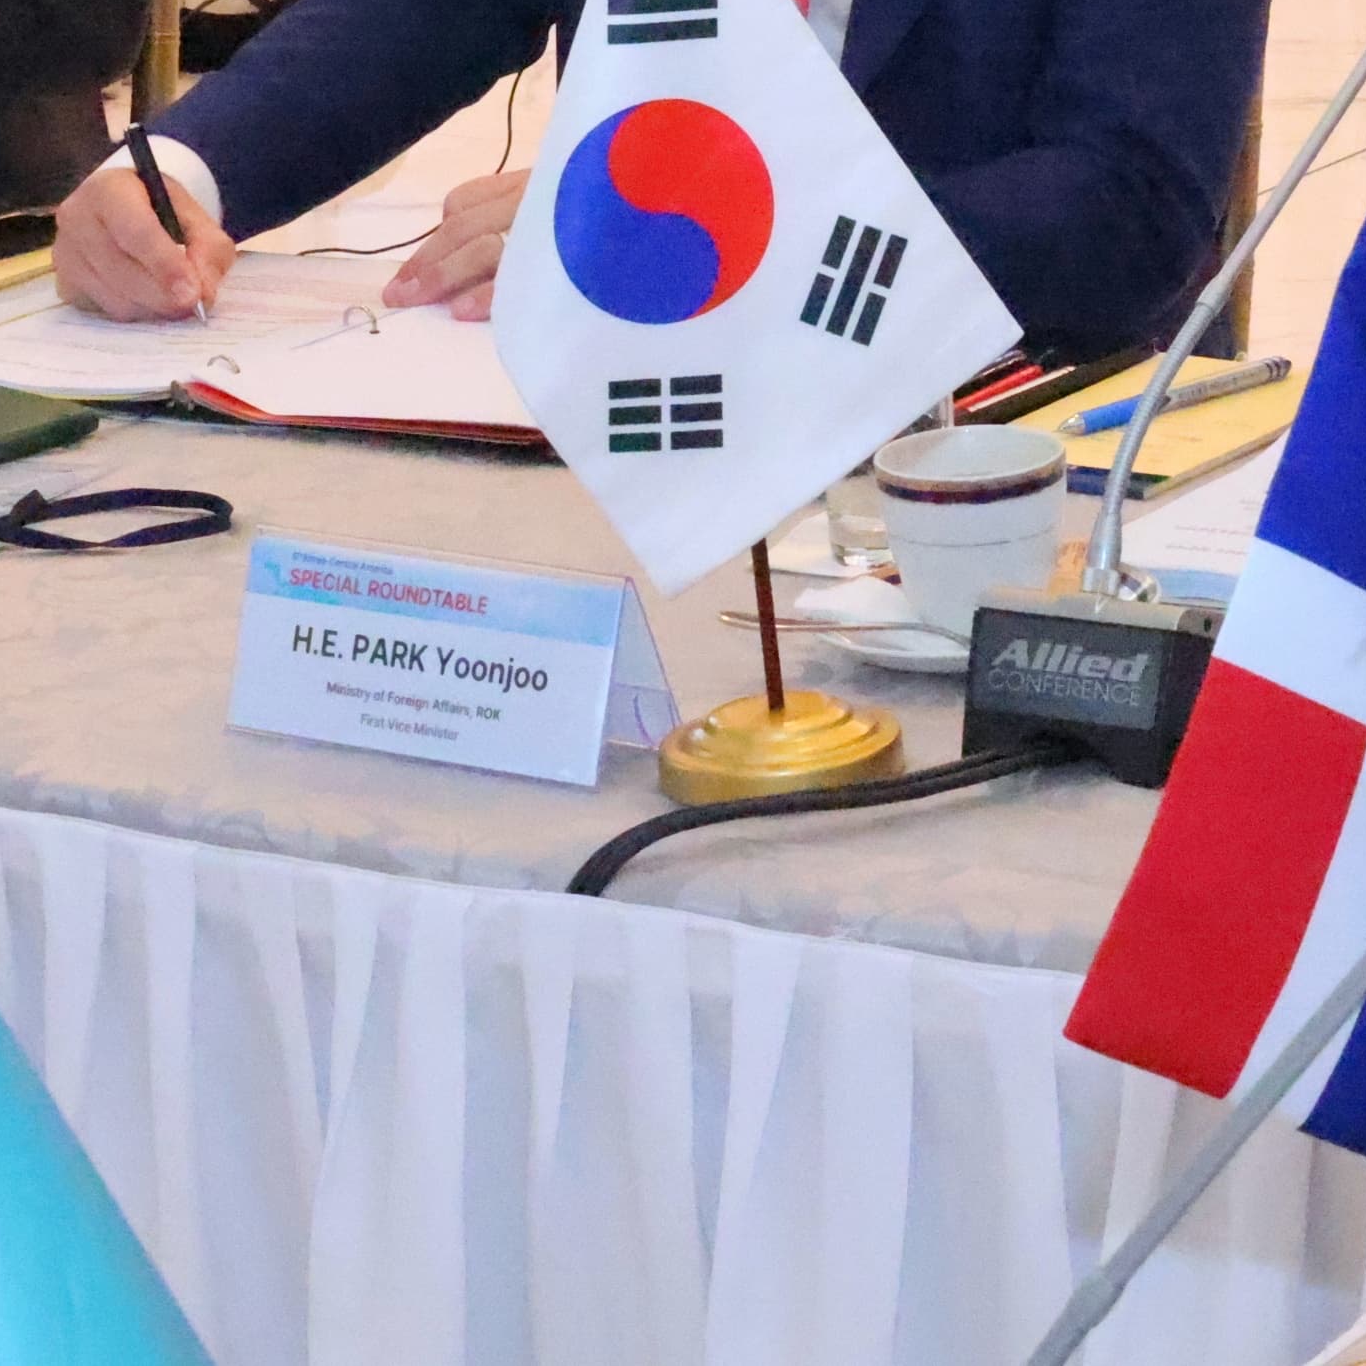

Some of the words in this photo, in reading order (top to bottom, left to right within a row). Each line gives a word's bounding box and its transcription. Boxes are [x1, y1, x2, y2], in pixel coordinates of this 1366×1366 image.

[289, 567, 362, 596] SPECIAL
[367, 579, 489, 615] ROUNDTABLE
[292, 624, 343, 660] H.E.
[351, 634, 425, 672] PARK
[437, 646, 549, 693] Yoonjoo
[990, 637, 1149, 682] Allied
[326, 681, 371, 703] Ministry
[373, 689, 385, 702] of
[386, 690, 429, 711] Foreign
[476, 705, 502, 721] ROK
[987, 667, 1141, 707] CONFERENCE
[360, 713, 384, 730] First
[386, 718, 412, 734] Vice
[413, 722, 460, 741] Minister
